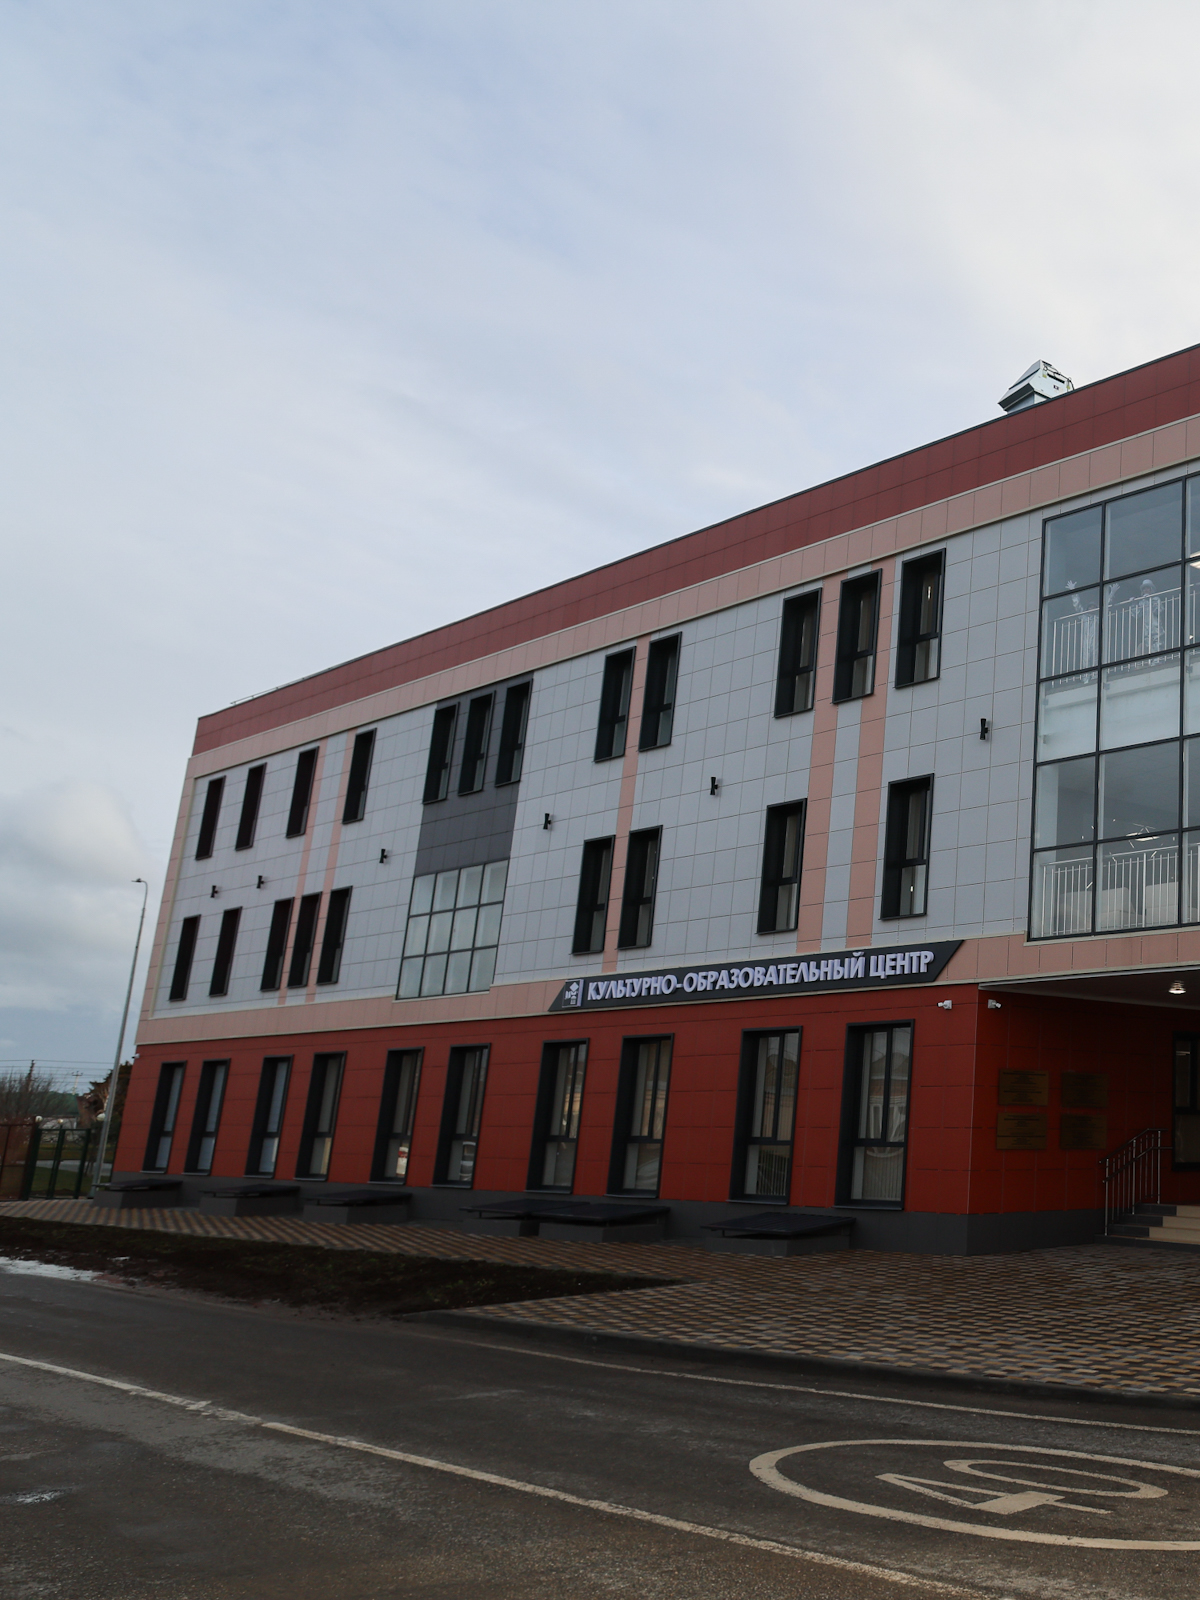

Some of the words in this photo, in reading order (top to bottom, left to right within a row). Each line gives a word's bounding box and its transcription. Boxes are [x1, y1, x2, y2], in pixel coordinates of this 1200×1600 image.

[587, 951, 866, 1001] КУЛЬТУРНО-ОБРАЗОВАТЕЛЬНЫЙ
[869, 950, 934, 979] ЦЕНТР
[875, 1459, 1169, 1515] 40
